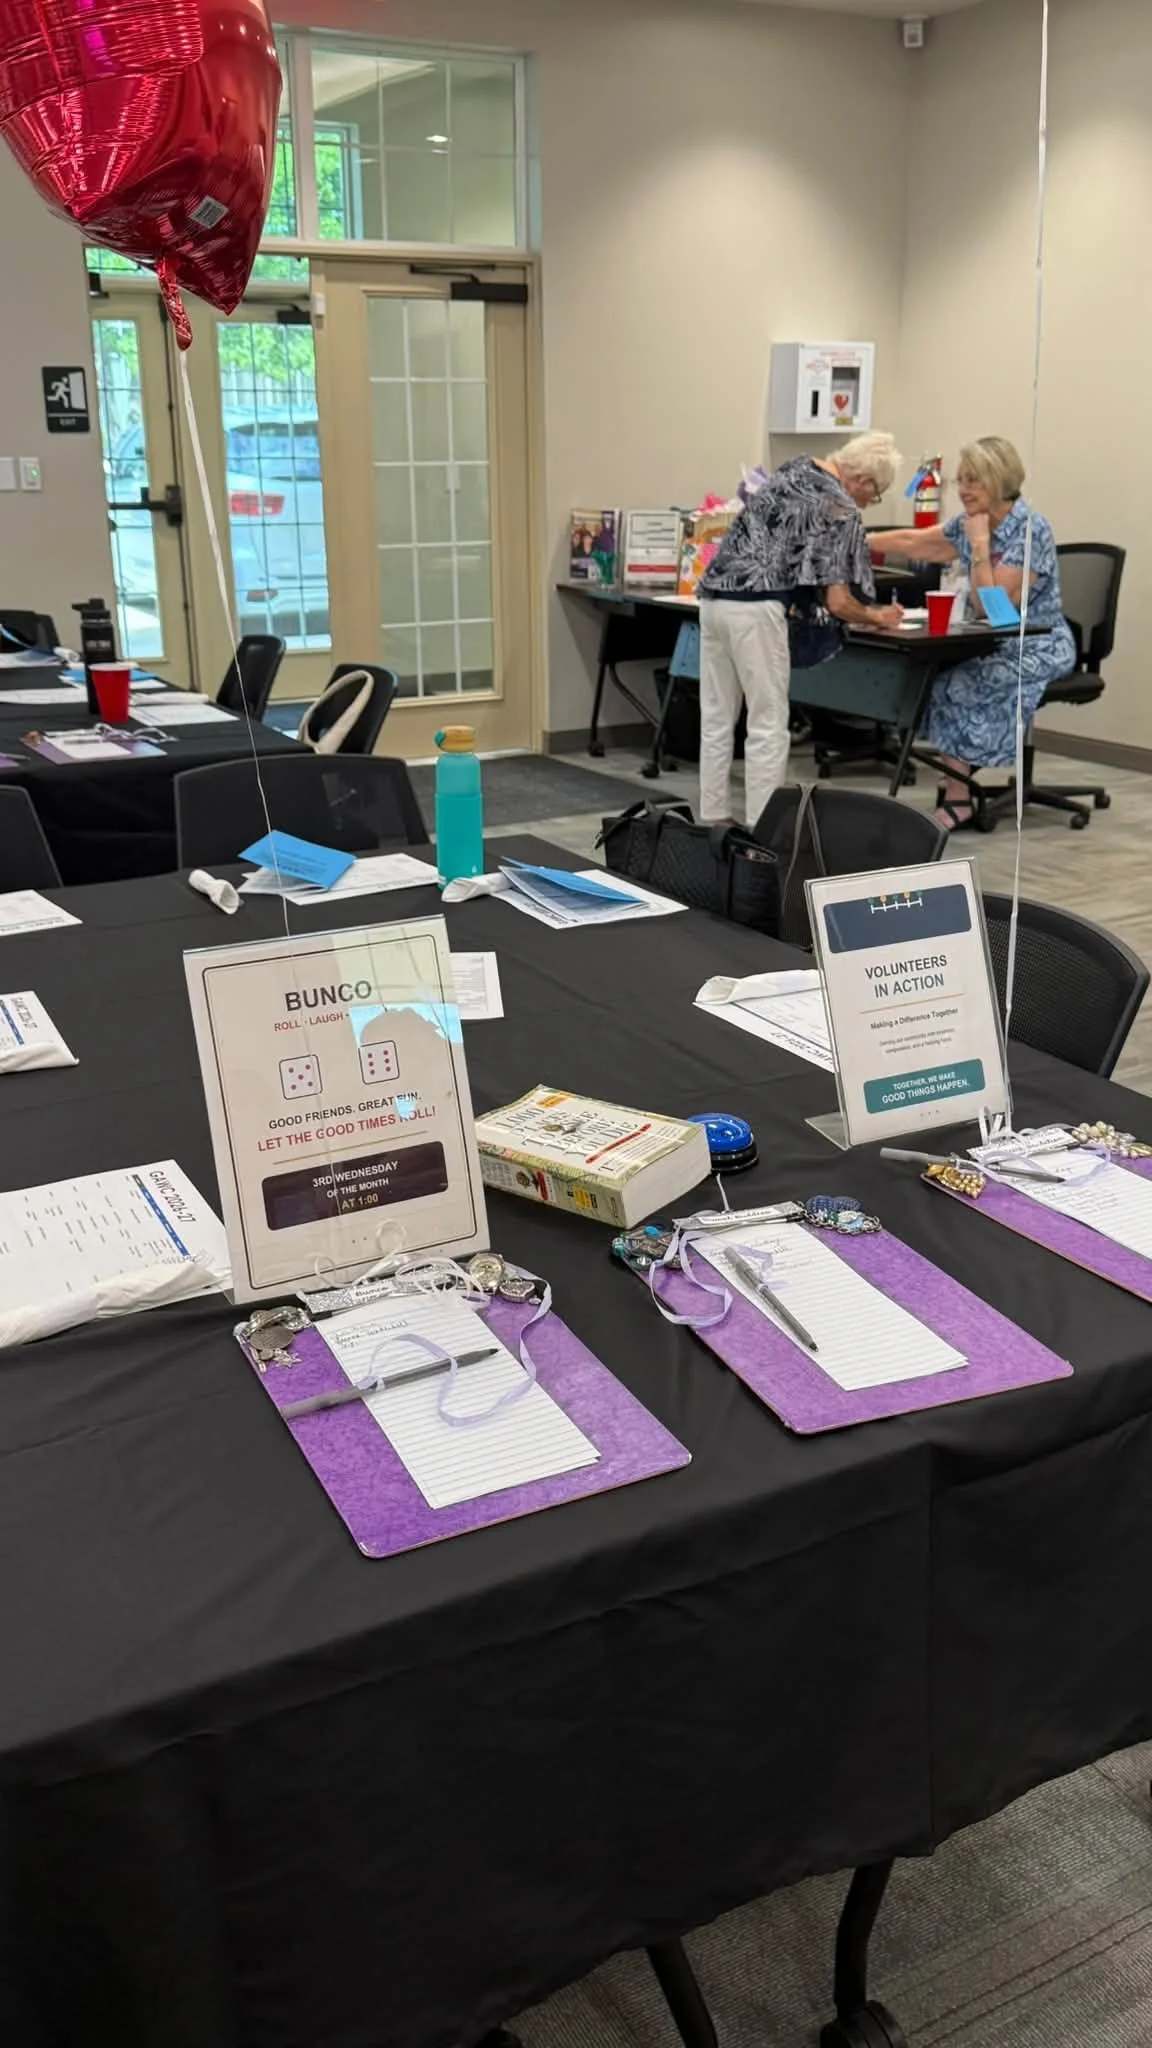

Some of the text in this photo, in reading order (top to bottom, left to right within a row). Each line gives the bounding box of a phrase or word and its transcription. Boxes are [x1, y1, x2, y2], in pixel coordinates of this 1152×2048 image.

[864, 954, 948, 980] VOLUNTEERS
[284, 979, 373, 1012] BUNCO
[873, 973, 945, 999] IN ACTION
[273, 1011, 344, 1032] ROLL LAUGH
[870, 1020, 894, 1030] Making
[898, 1012, 931, 1025] Difference
[931, 1008, 959, 1019] Together
[928, 1073, 938, 1082] WE
[938, 1071, 956, 1081] MAKE
[881, 1091, 906, 1104] GOOD
[906, 1085, 936, 1099] THINGS
[268, 1114, 303, 1130] GOOD
[305, 1105, 355, 1123] FRIENDS.
[358, 1096, 394, 1112] GREAT
[257, 1136, 283, 1152] LET
[285, 1130, 313, 1147] THE
[315, 1123, 355, 1140] GOOD
[357, 1114, 397, 1131] TIMES
[149, 1170, 176, 1195] GAWC
[312, 1160, 399, 1188] 3RD WEDNESDAY
[326, 1177, 389, 1199] OF THE MONTH
[341, 1193, 379, 1211] AT 1:00
